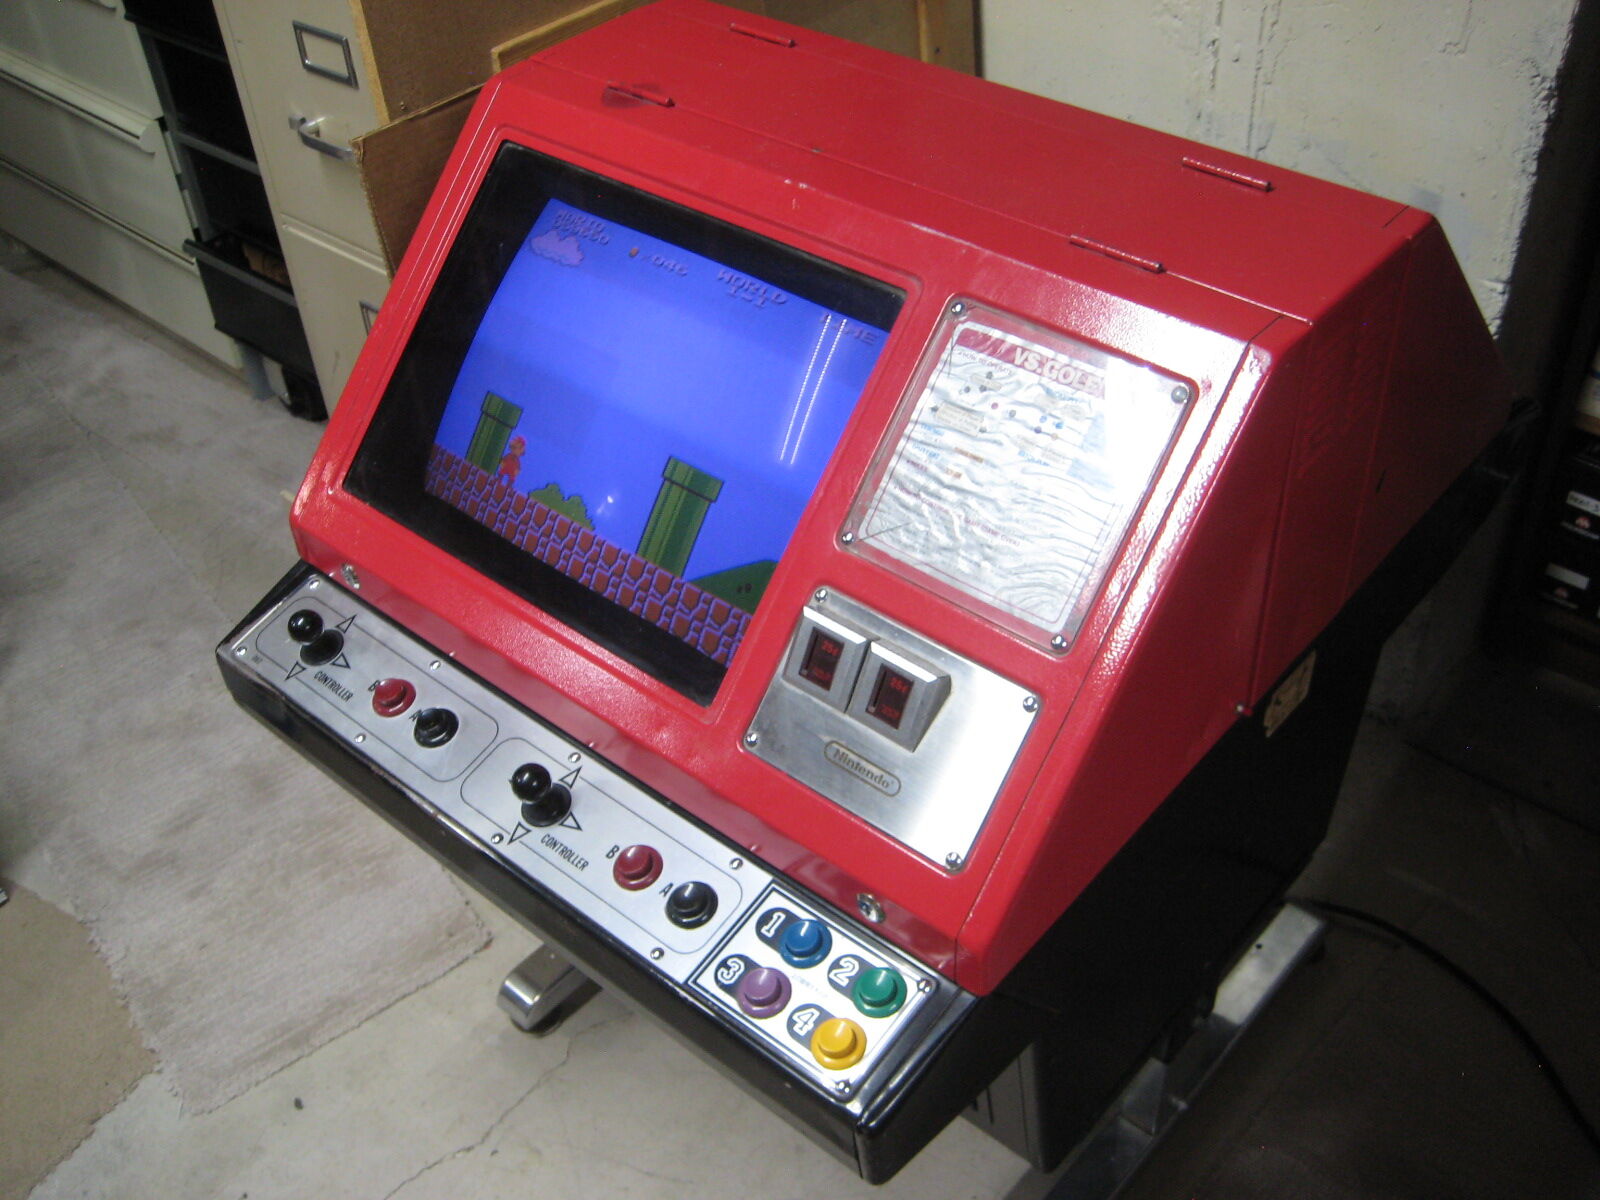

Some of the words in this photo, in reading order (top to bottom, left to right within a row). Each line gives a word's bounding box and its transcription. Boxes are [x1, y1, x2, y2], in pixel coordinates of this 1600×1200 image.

[717, 268, 787, 305] WORLD
[313, 669, 354, 702] CONTROLLER
[832, 746, 892, 790] Nintendo
[540, 834, 589, 872] CONTROLLER
[606, 845, 620, 859] B
[658, 882, 674, 898] A
[760, 910, 786, 938] 1
[717, 956, 745, 985] 3
[828, 955, 860, 987] 2
[792, 1006, 821, 1037] 4
